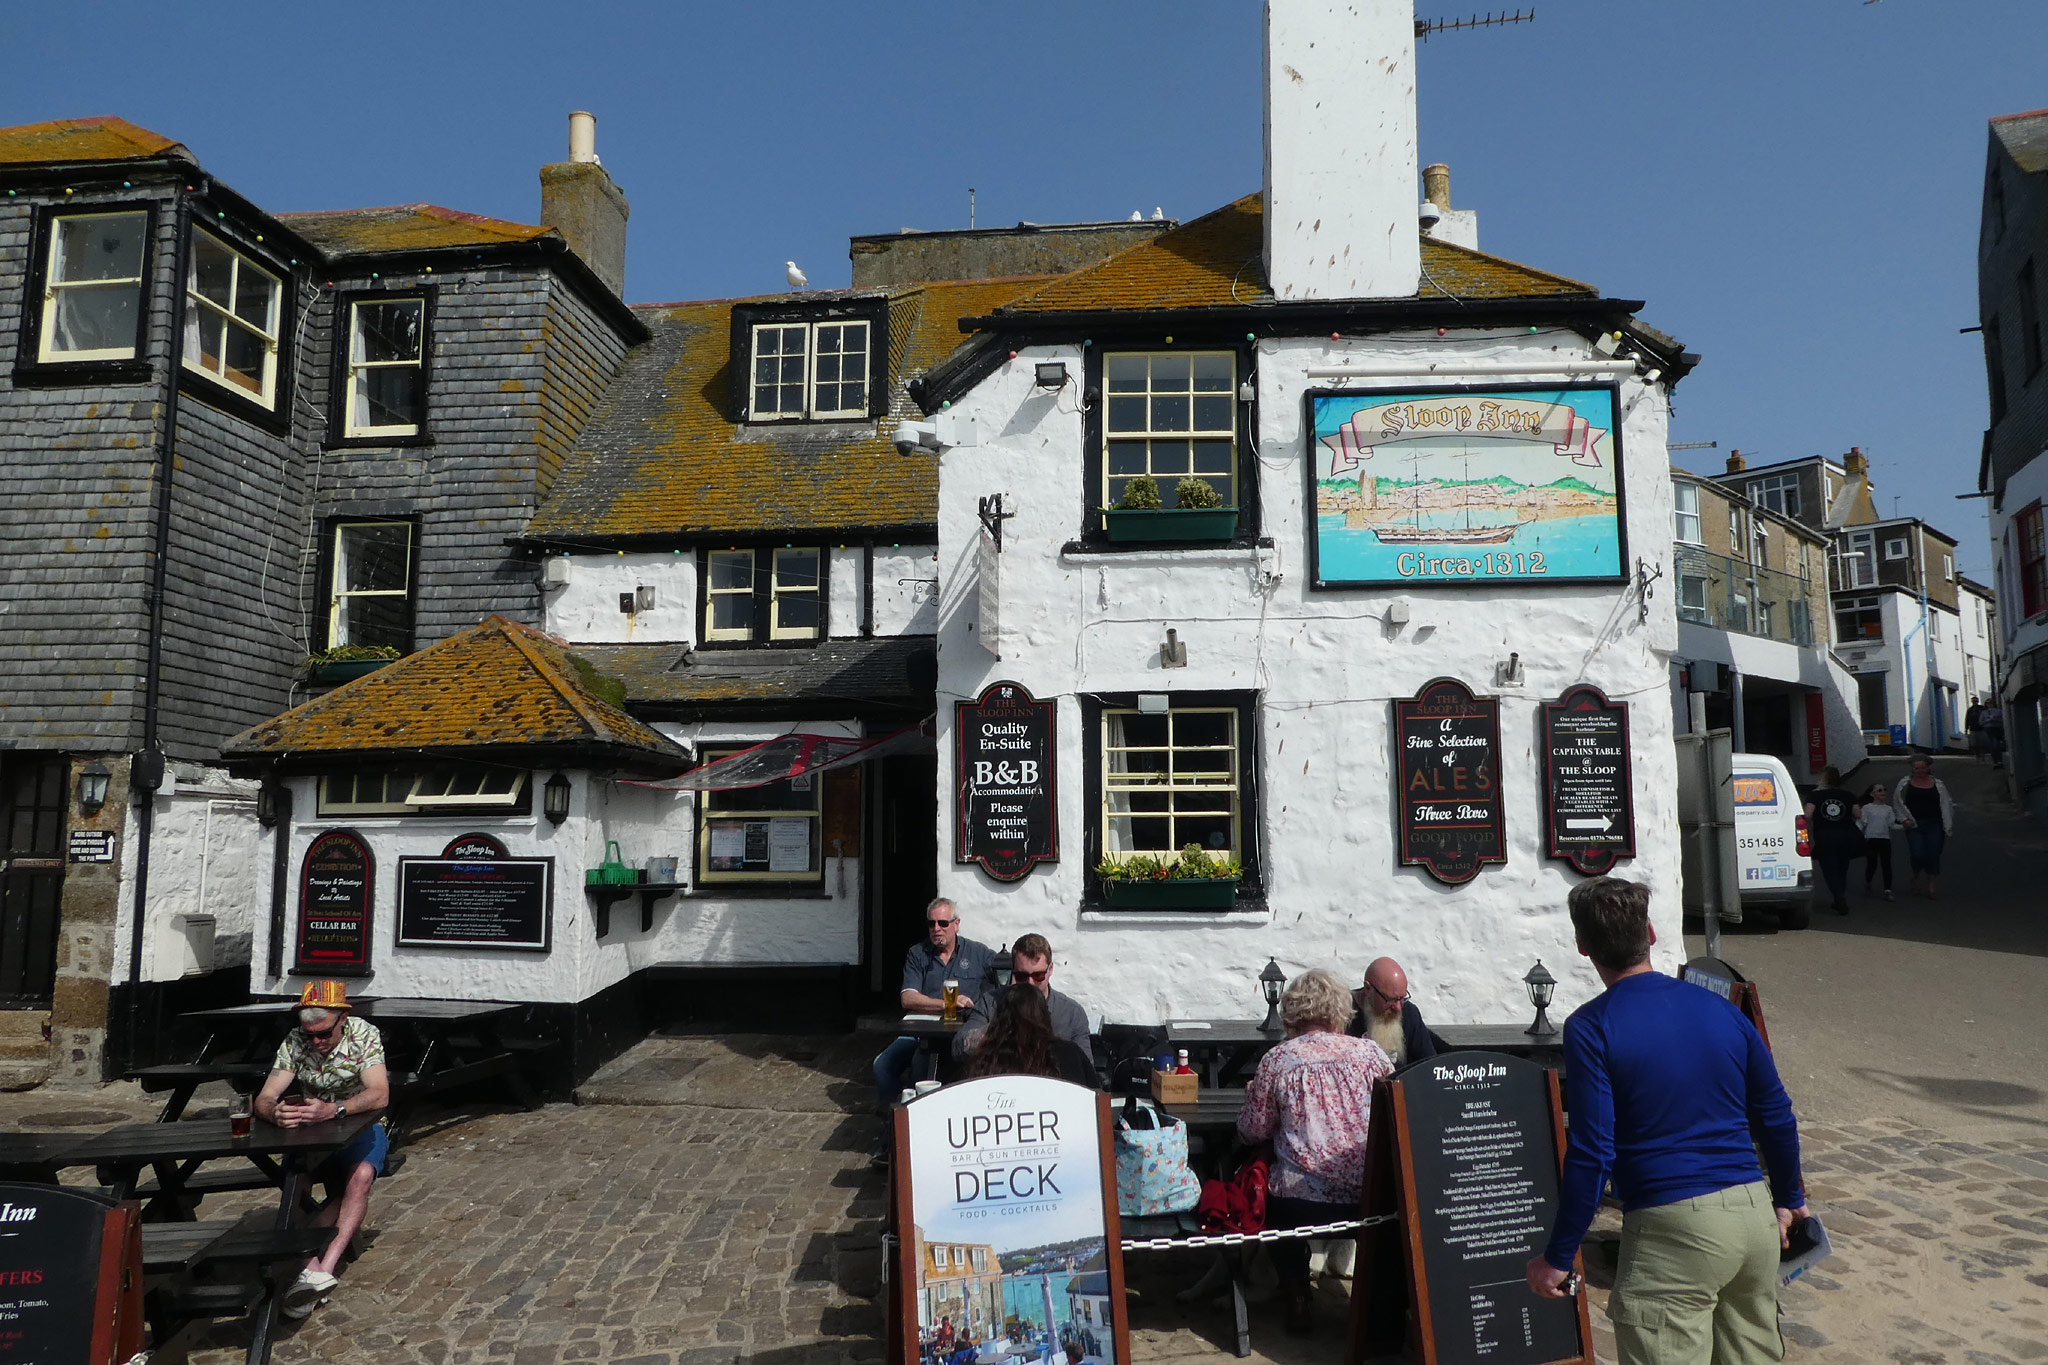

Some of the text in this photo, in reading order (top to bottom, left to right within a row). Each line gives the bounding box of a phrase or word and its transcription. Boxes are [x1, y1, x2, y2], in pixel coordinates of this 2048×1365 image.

[1381, 400, 1542, 438] Sloop Inn
[994, 699, 1016, 708] THE
[1435, 695, 1458, 704] THE
[977, 708, 1035, 718] SLOOP INN
[1417, 703, 1477, 714] SLOOP INN
[982, 723, 1028, 738] Quality
[979, 738, 1032, 750] En-Suite
[1407, 735, 1487, 749] Fine Selection
[1576, 738, 1597, 746] THE
[1553, 747, 1621, 756] CAPTAINS TABLE
[1442, 751, 1456, 767] of
[1582, 757, 1592, 766] @
[974, 760, 1039, 785] B&B
[1559, 766, 1616, 775] THE SLOOP
[1410, 766, 1491, 792] ALES
[990, 803, 1023, 813] Please
[1415, 805, 1488, 822] Three Bars
[987, 816, 1027, 829] enquire
[990, 828, 1024, 840] within
[1410, 832, 1494, 843] GOOD FOOD
[1739, 837, 1784, 848] 351485
[455, 844, 495, 856] The Sloop Inn
[310, 921, 357, 930] CELLAR BAR
[1433, 1063, 1507, 1083] The Sloop Inn
[1454, 1082, 1491, 1091] CIRCA 1312
[947, 1111, 1061, 1149] UPPER
[952, 1154, 973, 1163] BAR
[988, 1151, 1008, 1160] SUN
[1013, 1147, 1060, 1157] TERRACE
[955, 1163, 1062, 1204] DECK
[0, 1202, 37, 1222] Inn
[959, 1203, 1058, 1219] FOOD COCKTAILS
[18, 1299, 49, 1308] Tomato,
